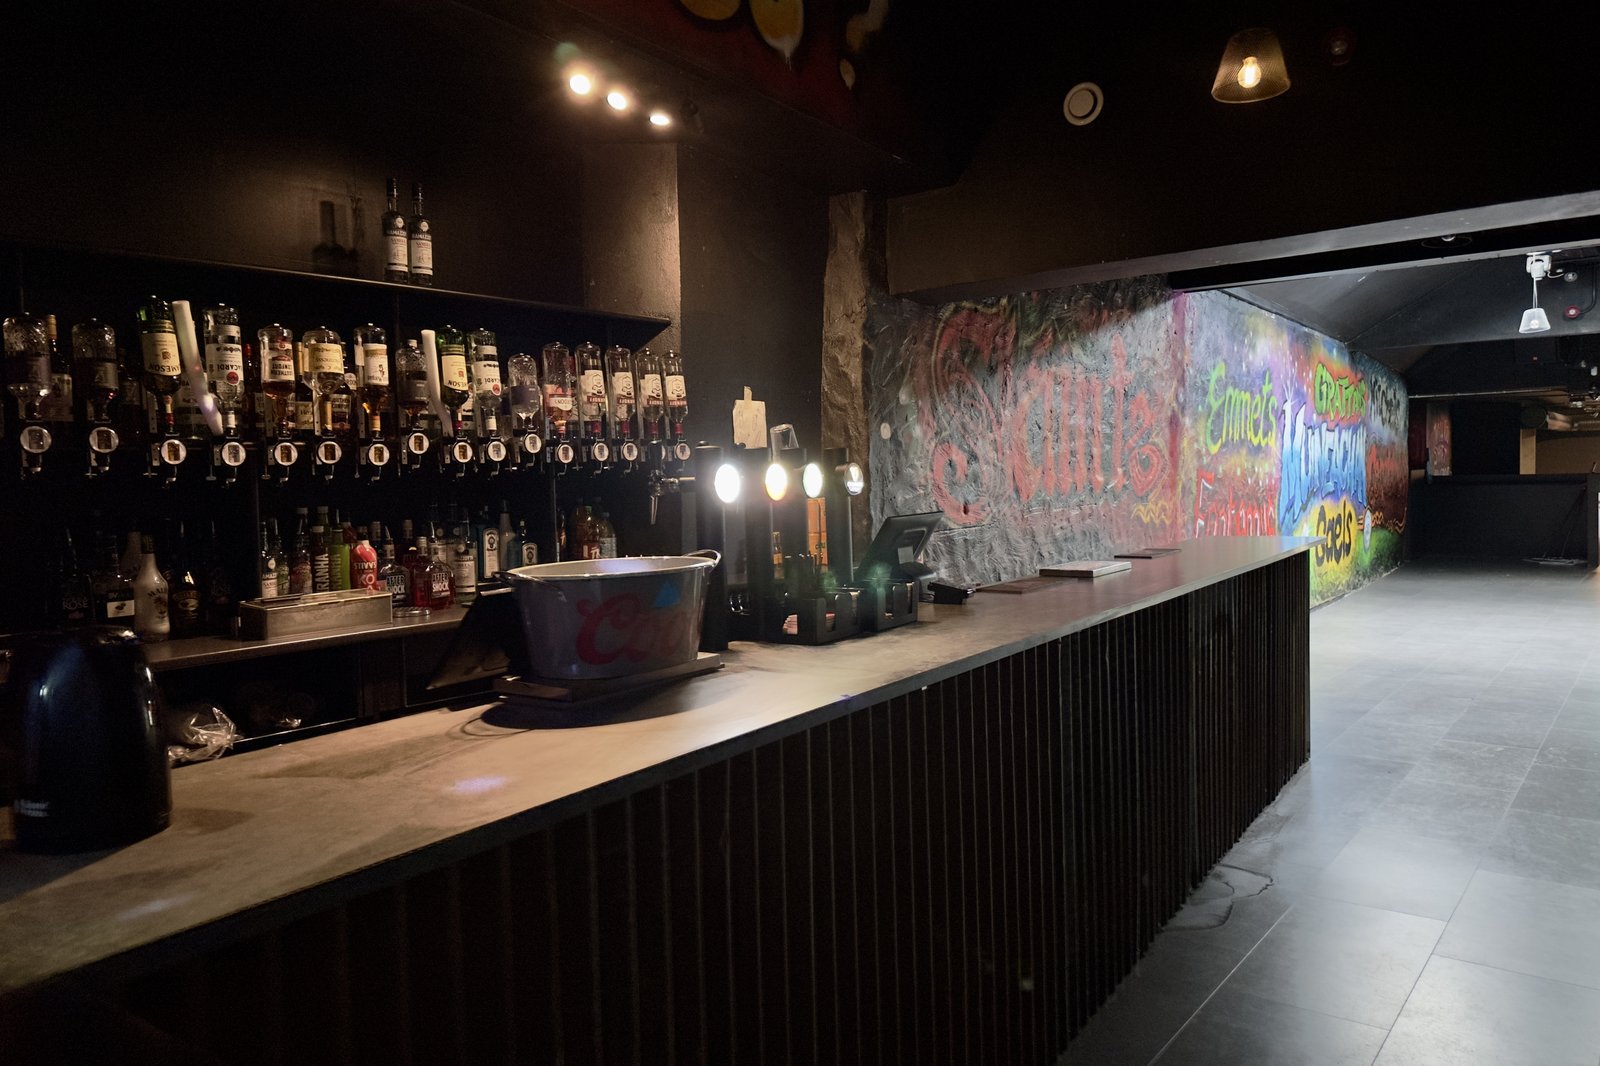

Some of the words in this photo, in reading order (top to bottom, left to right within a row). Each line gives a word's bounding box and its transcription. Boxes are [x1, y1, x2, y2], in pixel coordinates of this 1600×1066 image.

[1206, 361, 1278, 455] Emmets
[1315, 500, 1353, 568] Gaels
[313, 553, 330, 591] RANHA
[432, 582, 450, 592] SHOCK
